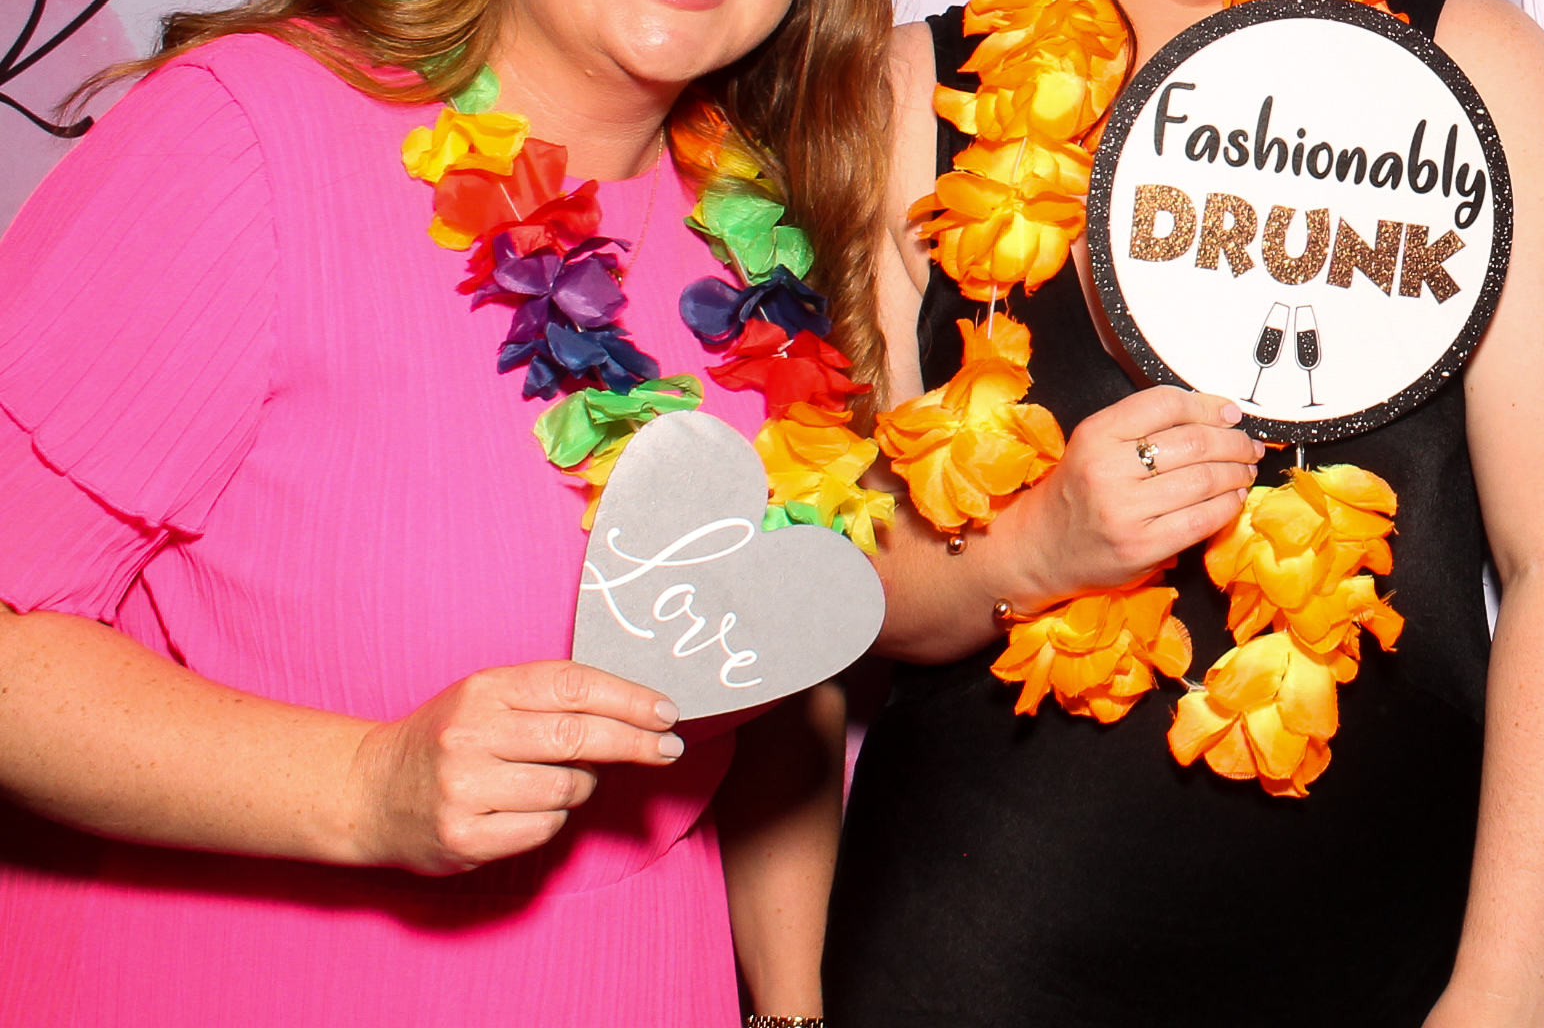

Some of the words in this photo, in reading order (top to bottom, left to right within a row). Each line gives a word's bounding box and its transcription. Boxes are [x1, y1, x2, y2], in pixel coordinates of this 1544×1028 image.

[1153, 81, 1487, 231] Fashionably
[1128, 183, 1467, 305] DRUNK
[580, 517, 763, 689] Love
